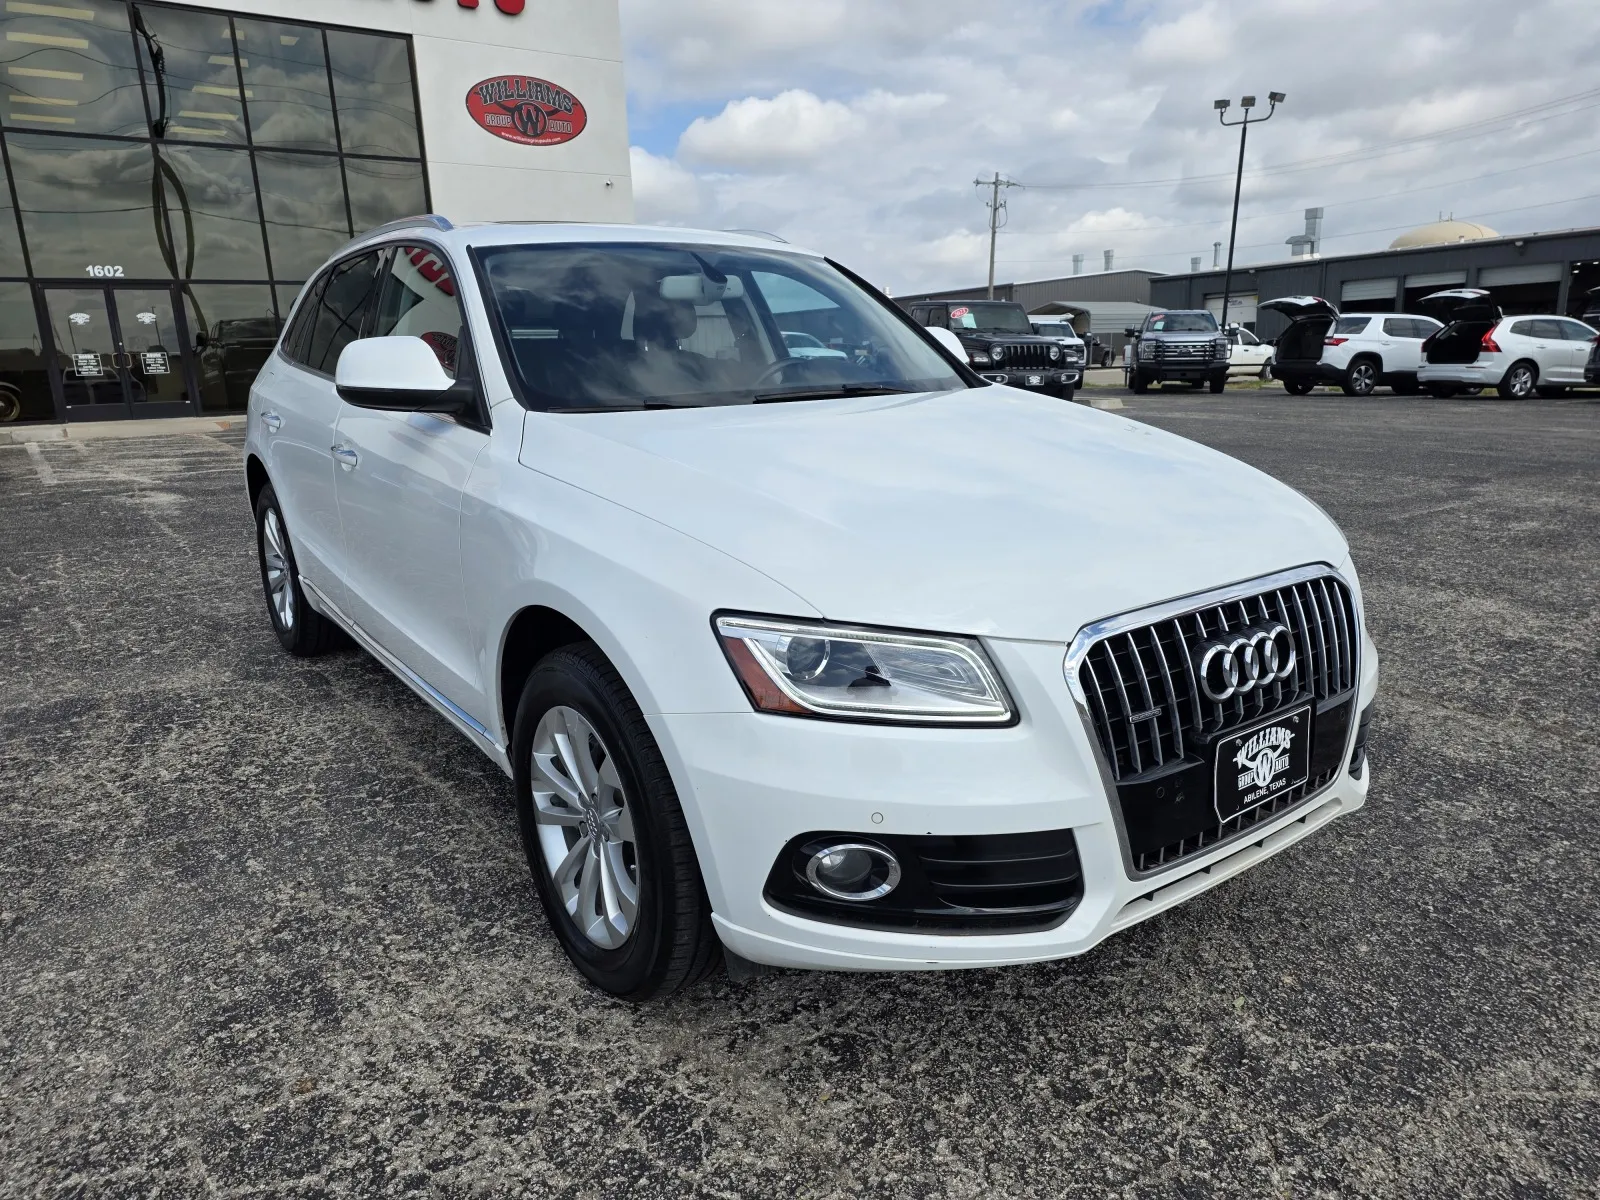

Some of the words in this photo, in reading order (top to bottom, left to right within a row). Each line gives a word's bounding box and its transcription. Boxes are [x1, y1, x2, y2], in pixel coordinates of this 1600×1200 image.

[478, 79, 573, 115] WILLIAMS
[485, 114, 512, 126] GROUP
[549, 120, 573, 133] AUTO
[86, 265, 124, 277] 1602
[1236, 727, 1292, 769] WILLIAMS
[1274, 756, 1290, 772] AUTO
[1237, 771, 1255, 789] GROUP
[1243, 787, 1269, 804] ABILENE,
[1269, 778, 1287, 792] TEXAS
